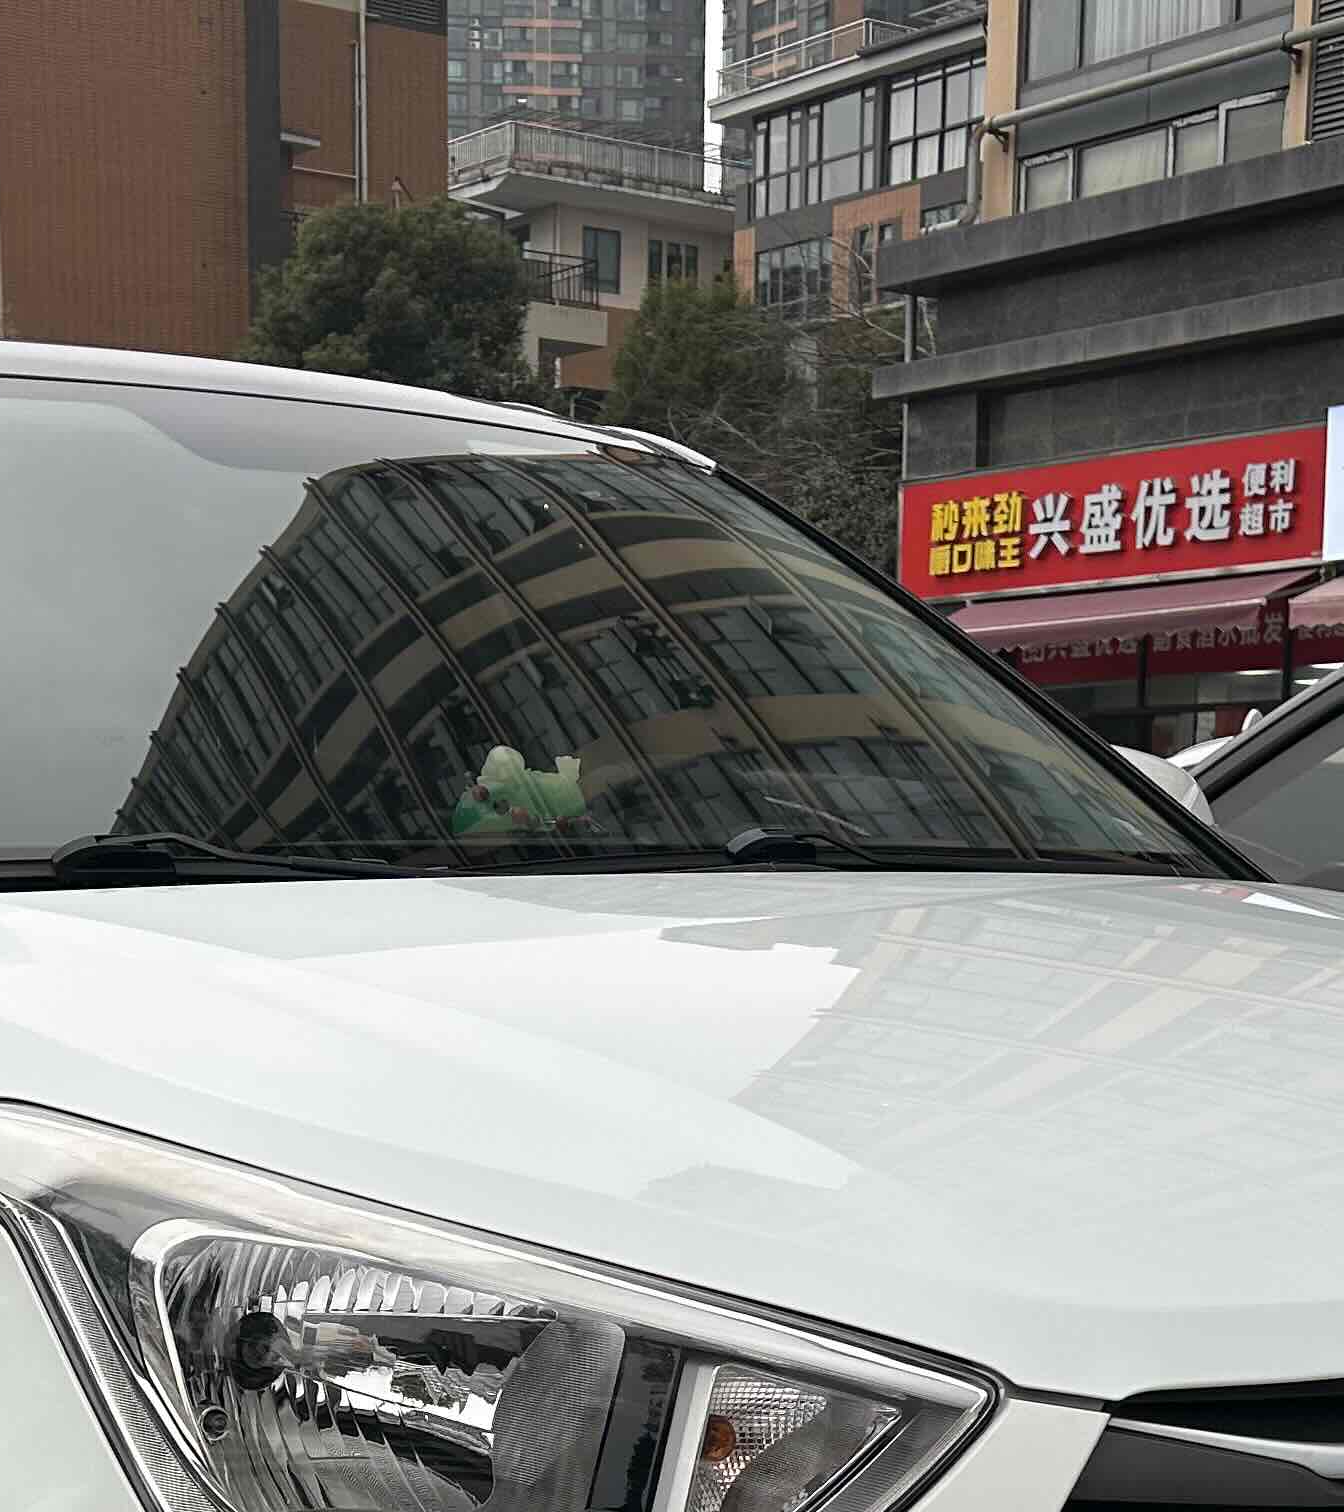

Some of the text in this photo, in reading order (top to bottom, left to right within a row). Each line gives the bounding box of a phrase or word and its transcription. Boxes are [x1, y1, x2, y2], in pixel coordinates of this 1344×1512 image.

[1241, 458, 1297, 497] 便利
[1028, 467, 1233, 560] 兴盛优选
[1238, 498, 1295, 536] 超市
